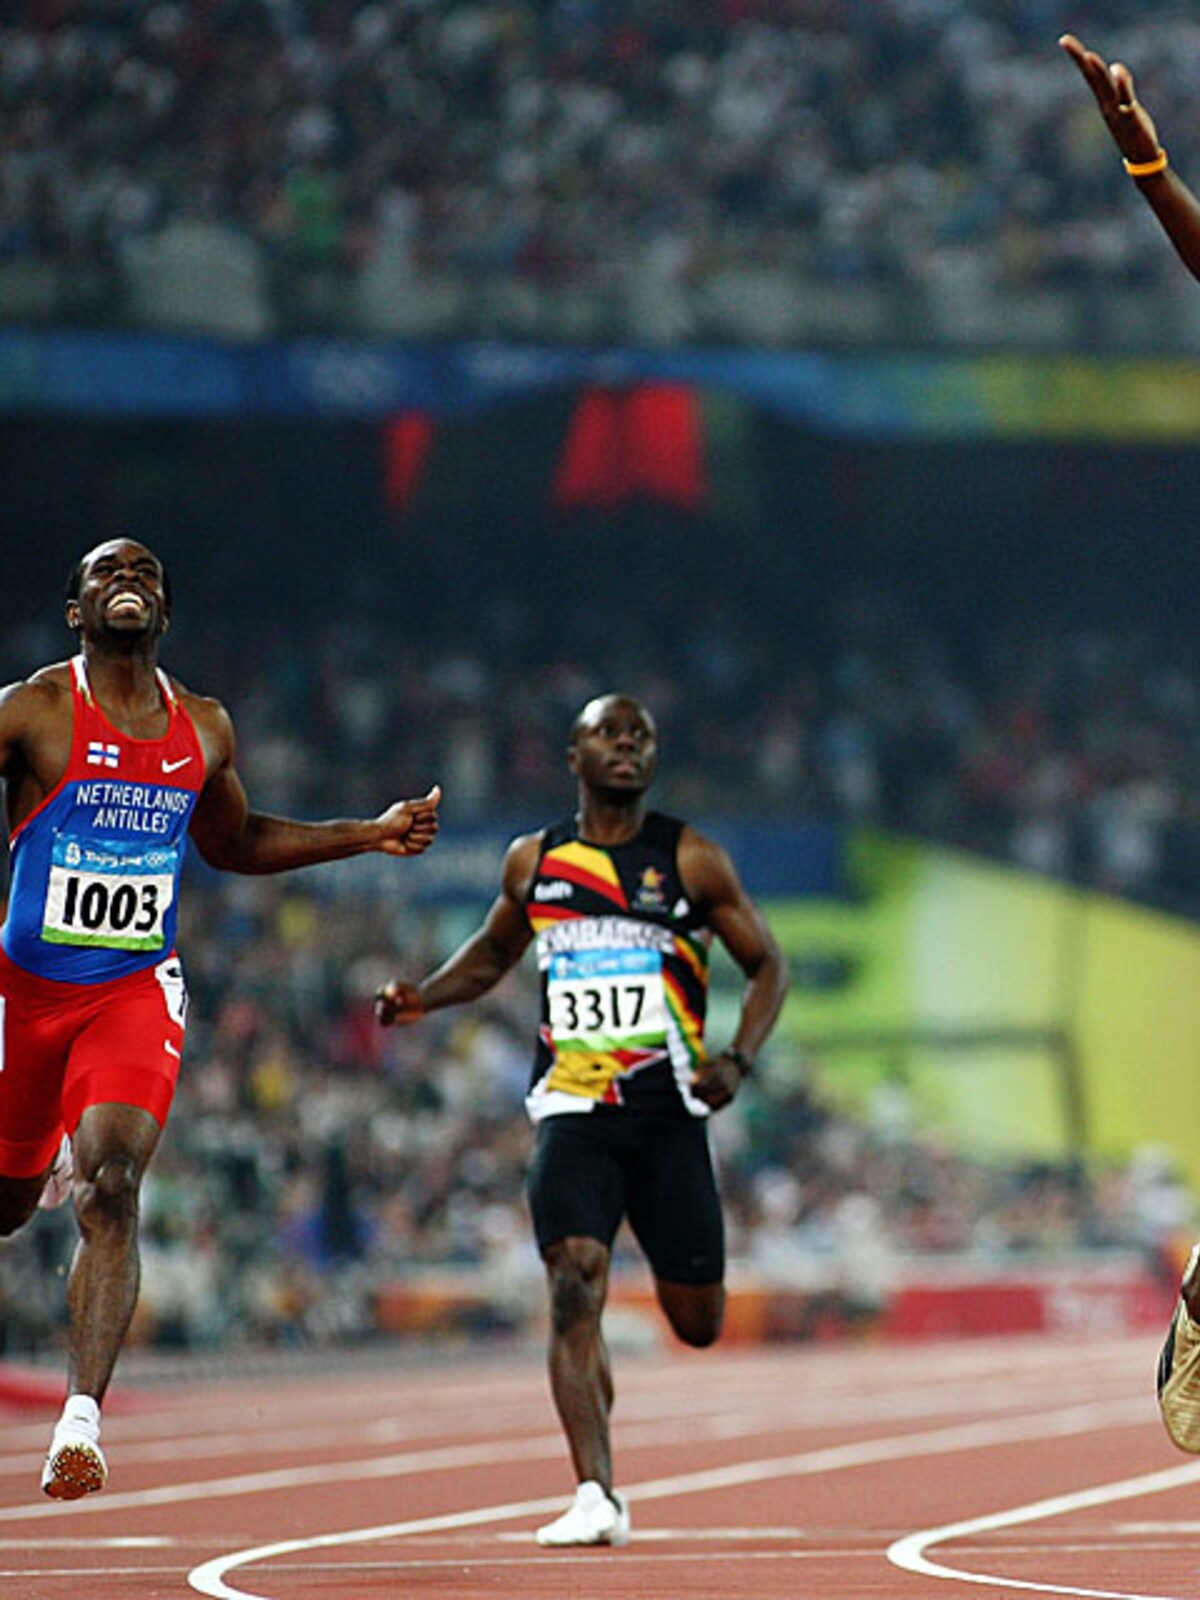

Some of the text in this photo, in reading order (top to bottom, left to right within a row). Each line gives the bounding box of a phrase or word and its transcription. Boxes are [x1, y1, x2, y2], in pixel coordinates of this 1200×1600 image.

[76, 784, 190, 814] NETHERLANDS
[92, 807, 170, 834] ANTILLES
[62, 876, 159, 933] 1003
[562, 985, 646, 1032] 3317
